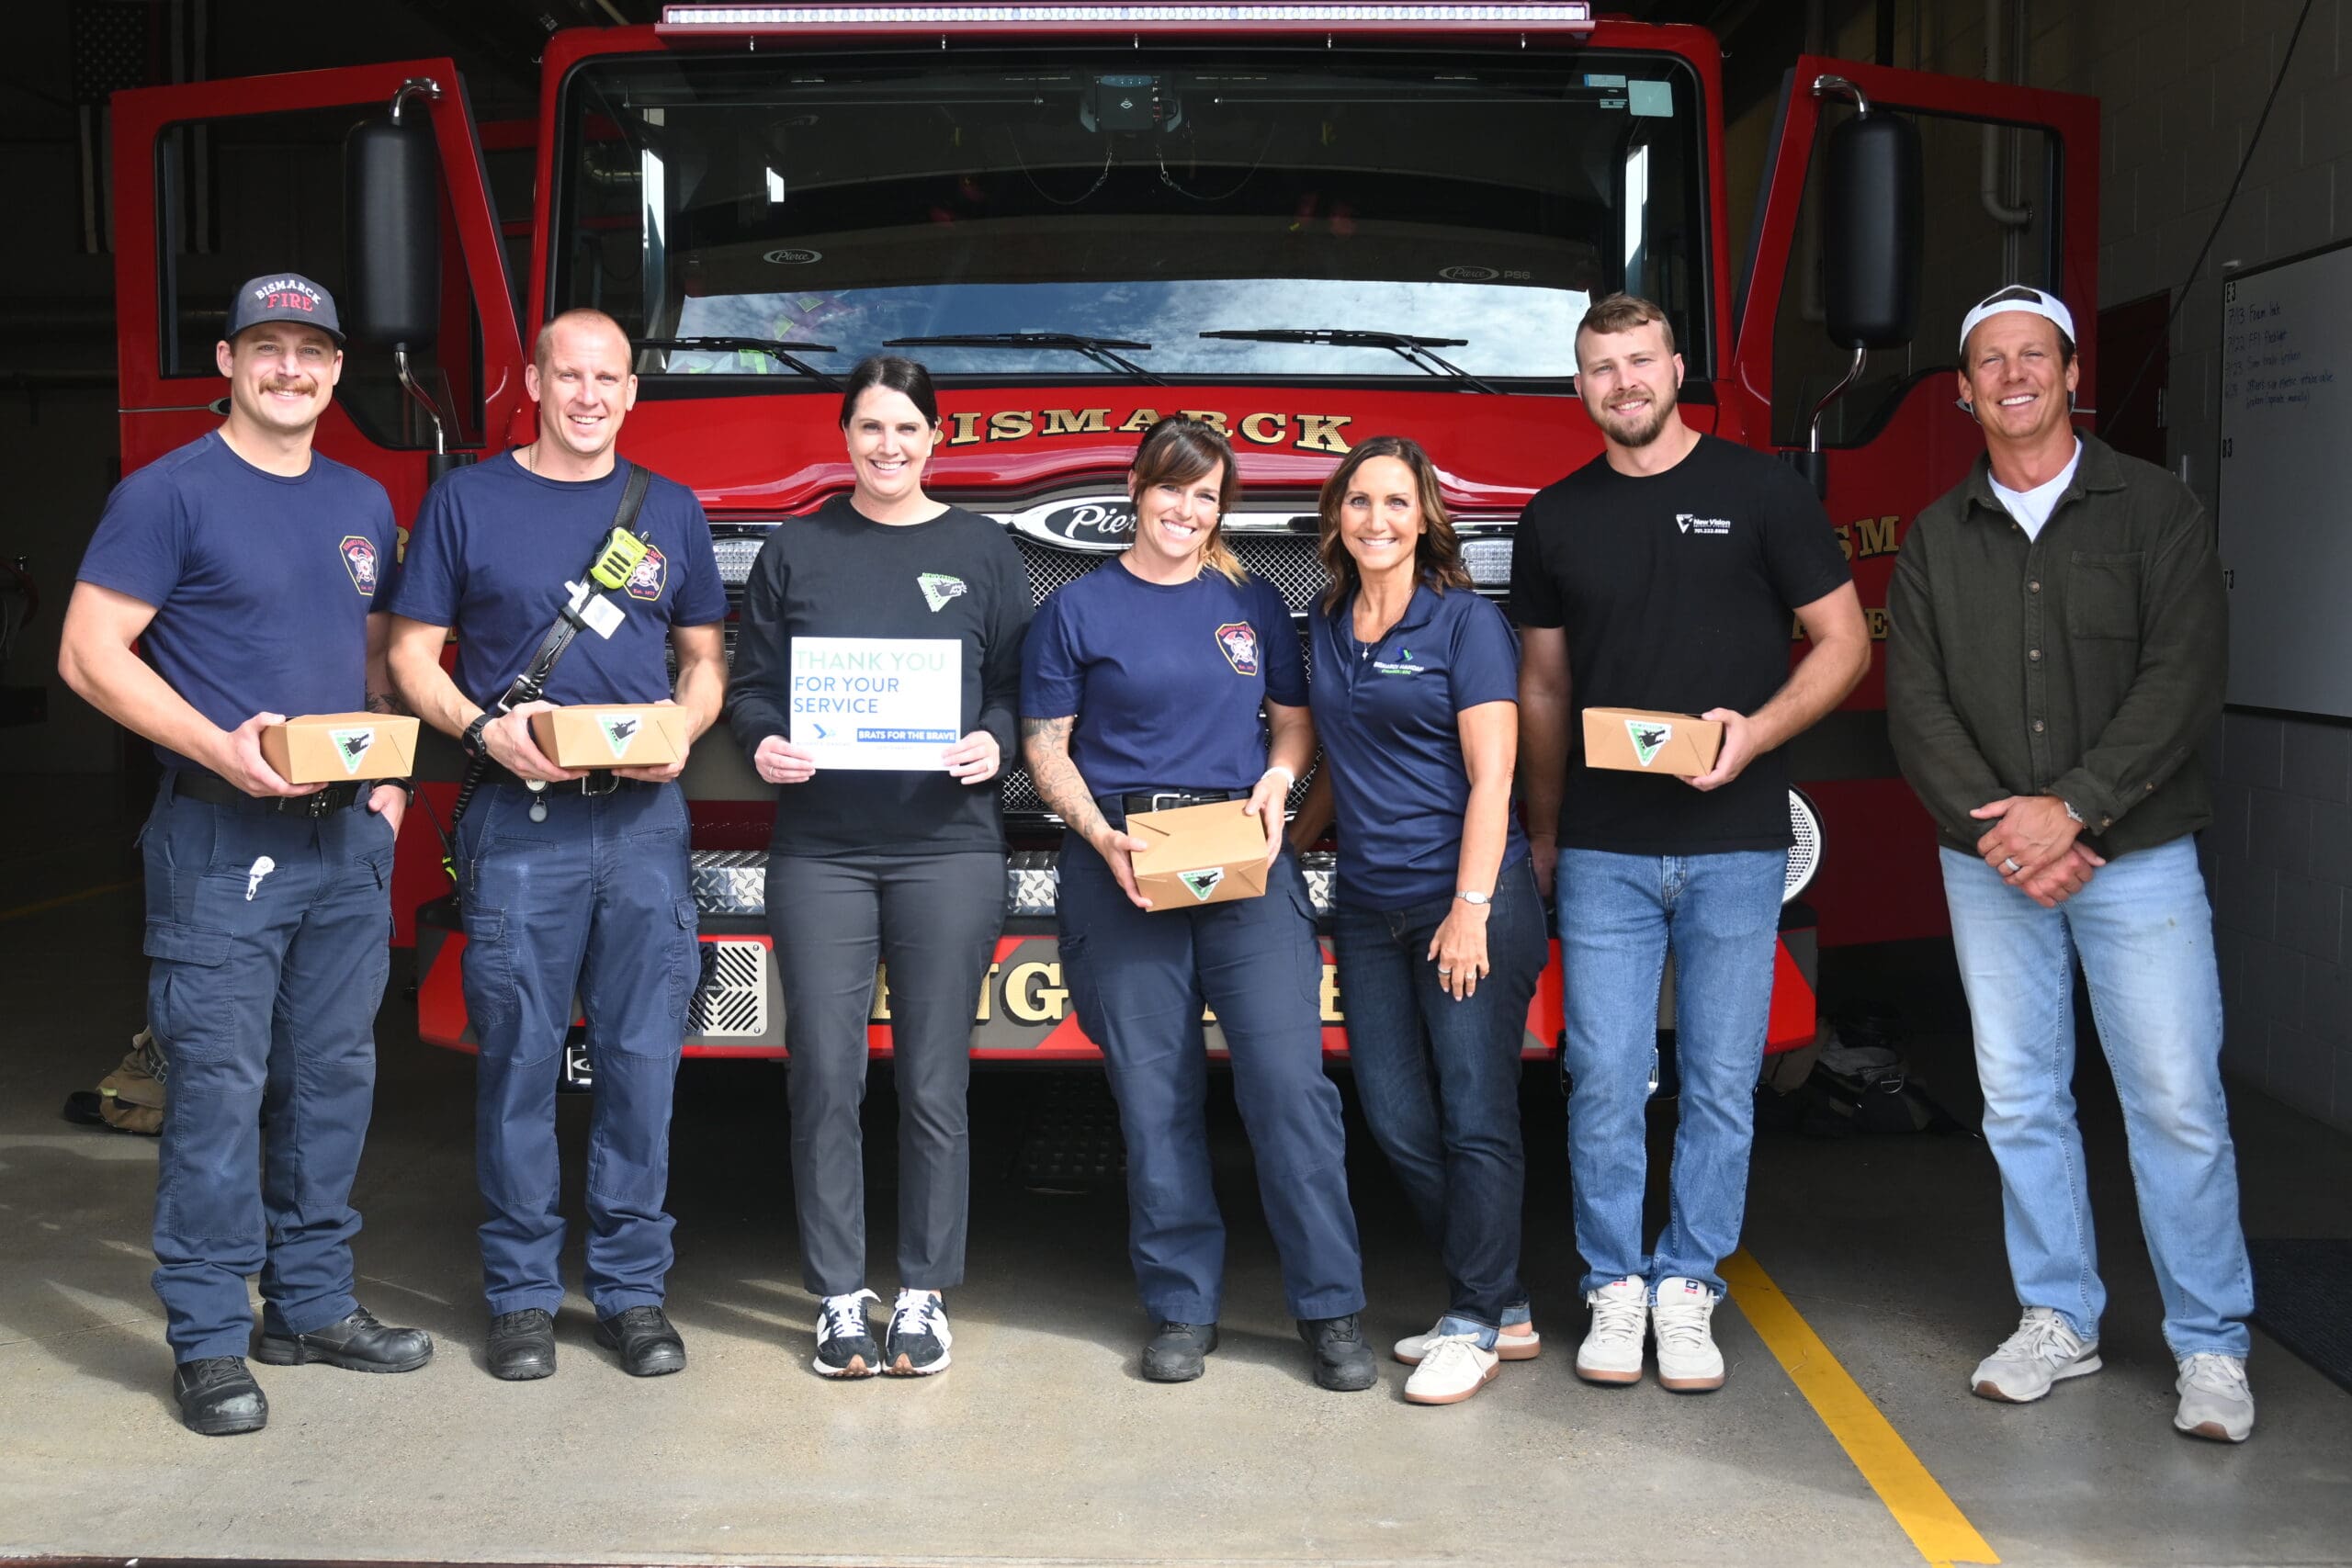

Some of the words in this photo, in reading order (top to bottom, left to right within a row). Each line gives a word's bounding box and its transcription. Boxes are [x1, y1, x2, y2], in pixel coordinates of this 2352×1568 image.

[254, 279, 322, 305] BISMARCK
[266, 292, 313, 312] FIRE
[933, 410, 1352, 454] ISMARCK
[1064, 504, 1138, 539] Pier
[1710, 518, 1731, 526] Vision
[797, 650, 883, 671] THANK
[890, 653, 944, 671] YOU
[795, 676, 836, 692] FOR
[842, 677, 899, 693] YOUR
[794, 697, 878, 714] SERVICE
[858, 729, 886, 740] BRATS
[887, 730, 905, 741] FOR
[908, 731, 924, 741] THE
[926, 732, 956, 741] BRAVE
